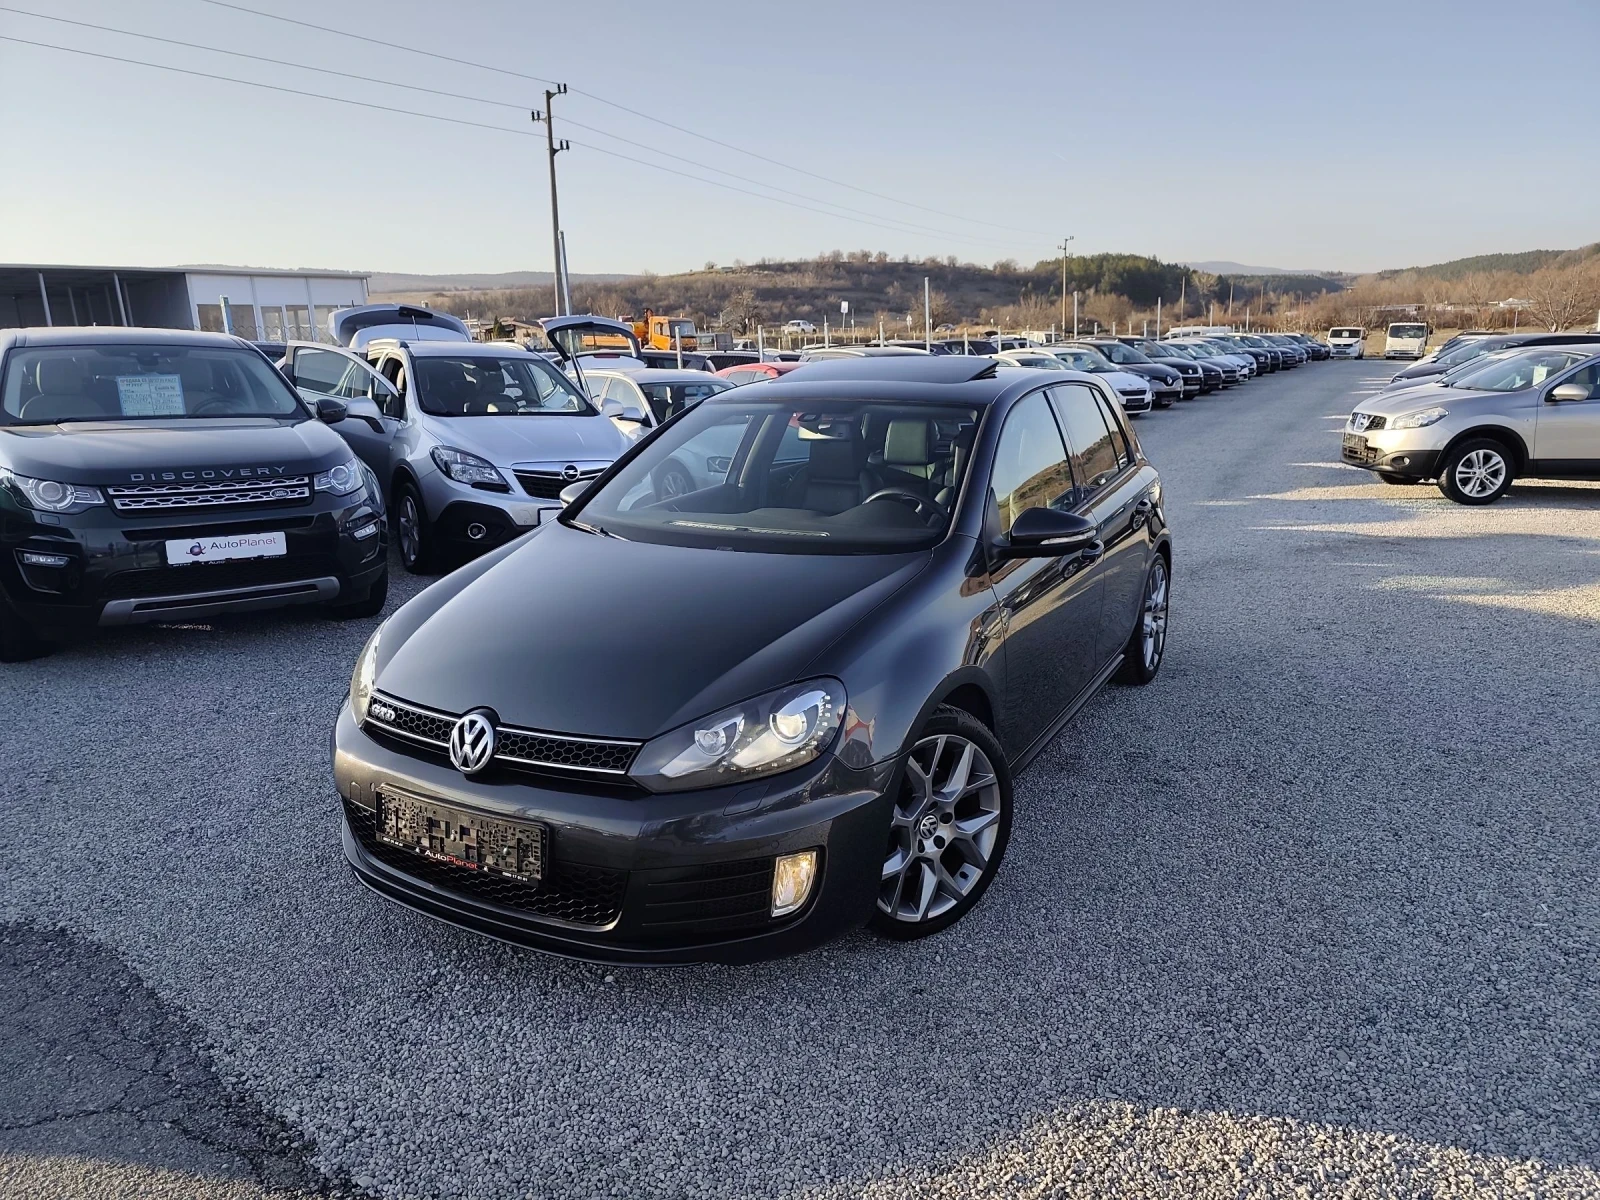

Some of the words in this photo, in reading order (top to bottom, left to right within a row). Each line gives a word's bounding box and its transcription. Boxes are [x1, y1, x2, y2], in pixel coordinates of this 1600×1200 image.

[130, 466, 286, 481] DISCOVERY
[210, 536, 277, 550] AutoPlanet
[371, 703, 396, 721] GTD
[424, 850, 478, 870] AutoPlanet
